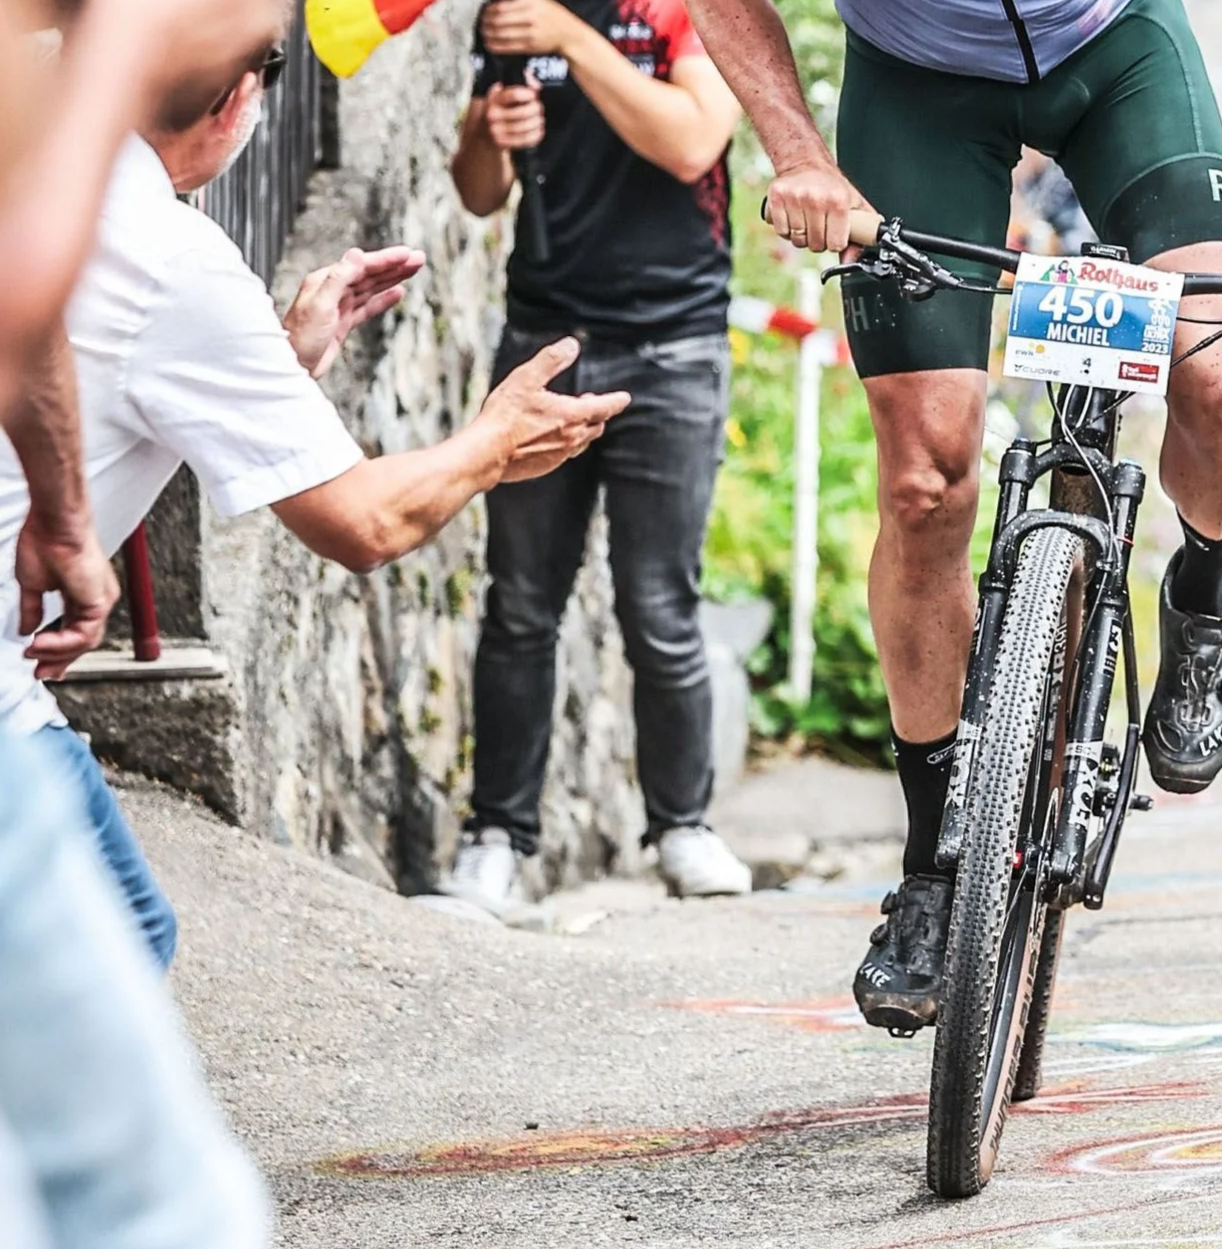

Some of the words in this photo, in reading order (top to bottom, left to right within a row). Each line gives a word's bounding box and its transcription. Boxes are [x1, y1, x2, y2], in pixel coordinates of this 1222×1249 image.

[1077, 262, 1159, 292] Rothaus
[1038, 286, 1124, 328] 450
[1046, 323, 1110, 346] MICHIEL
[1141, 342, 1168, 354] 2023
[860, 962, 890, 988] LAKE
